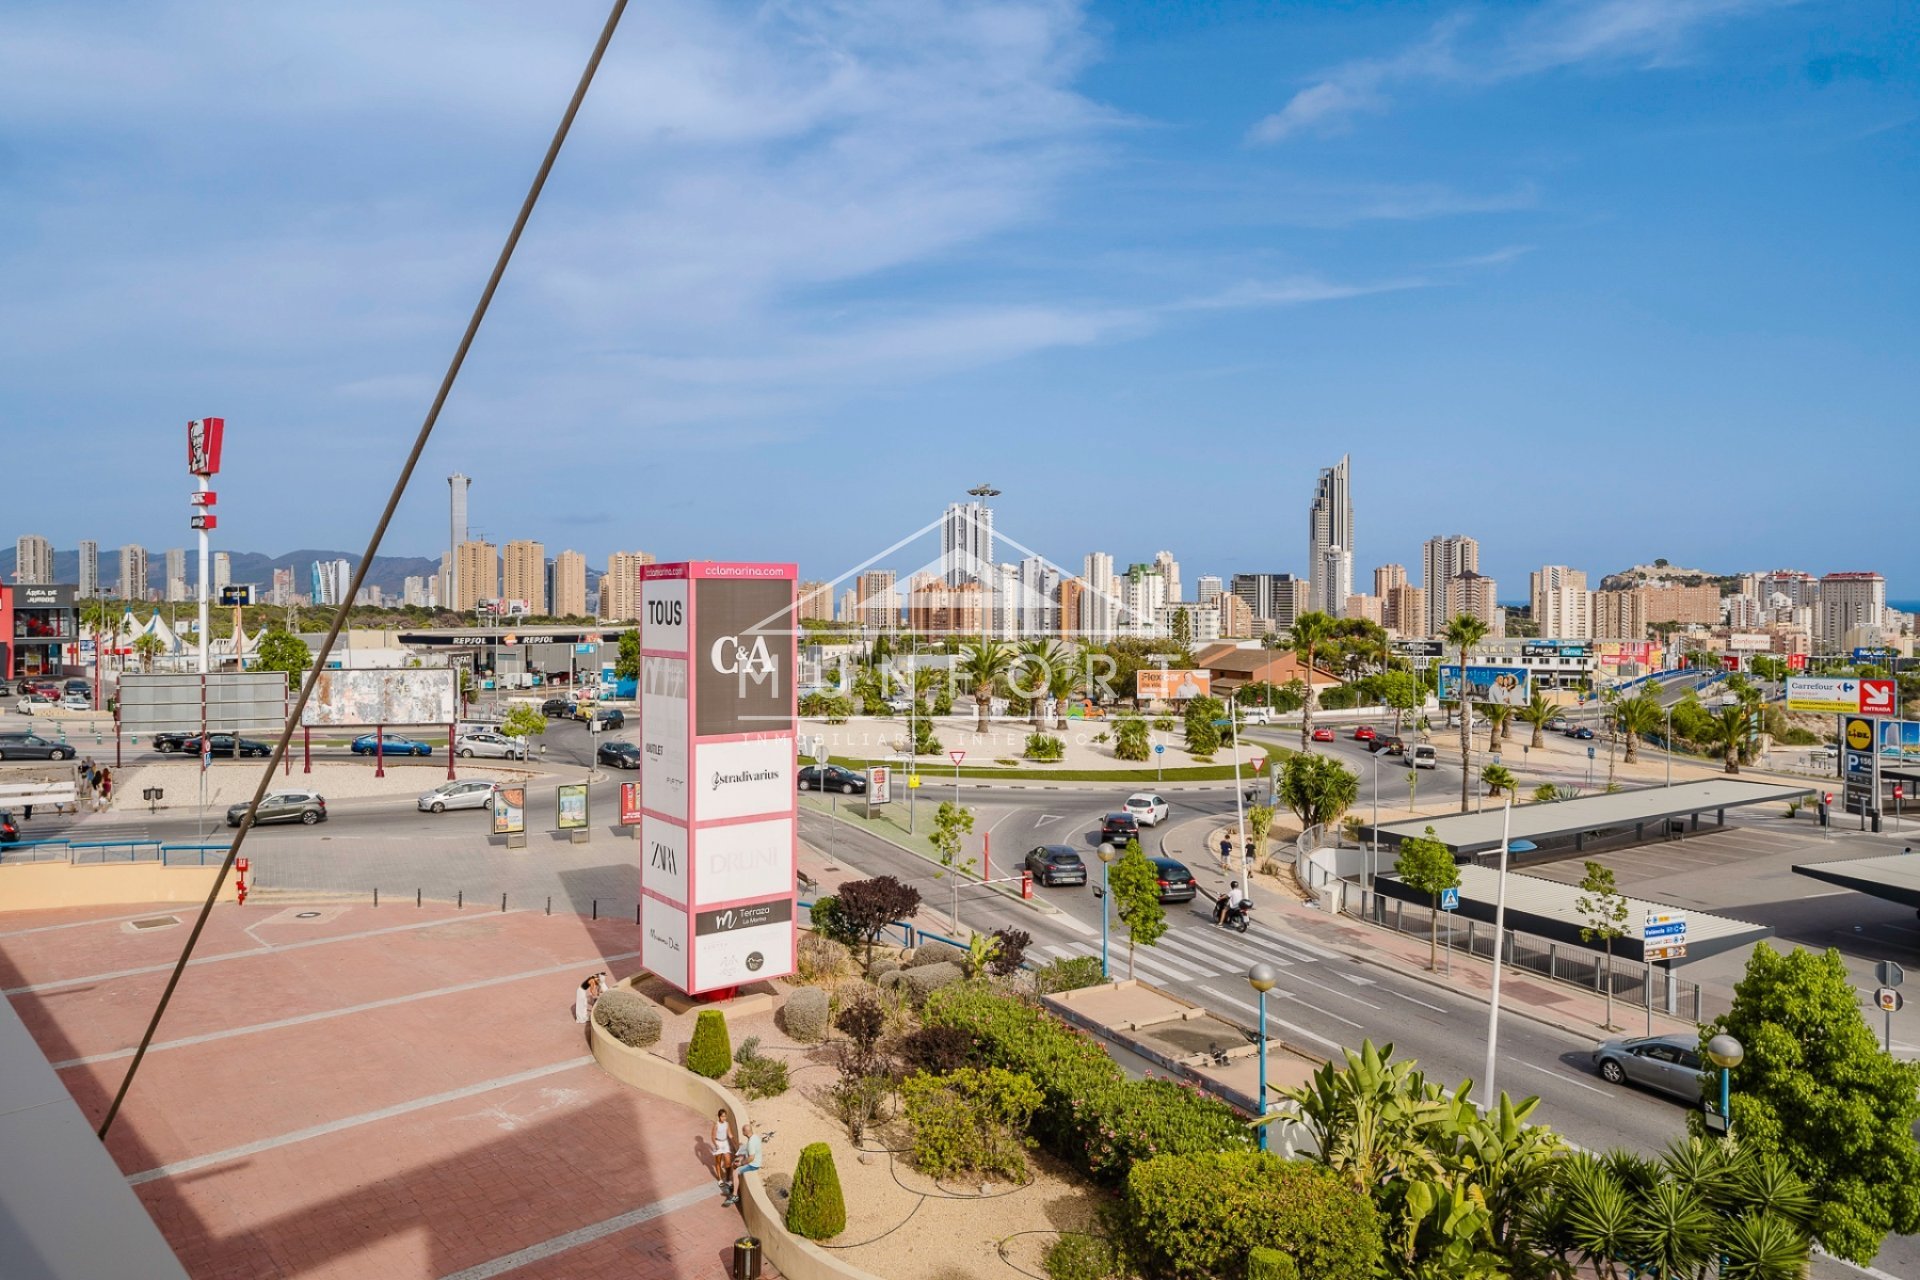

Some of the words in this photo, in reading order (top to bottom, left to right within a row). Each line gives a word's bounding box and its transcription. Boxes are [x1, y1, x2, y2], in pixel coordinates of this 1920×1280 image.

[705, 566, 784, 576] cclamarina.com
[648, 600, 682, 625] TOUS
[453, 637, 487, 645] REPSOL
[522, 636, 554, 644] REPSOL
[711, 635, 776, 674] C&A
[1791, 682, 1833, 691] Carrefour
[710, 846, 777, 875] DRUNI
[739, 907, 770, 918] Terraza
